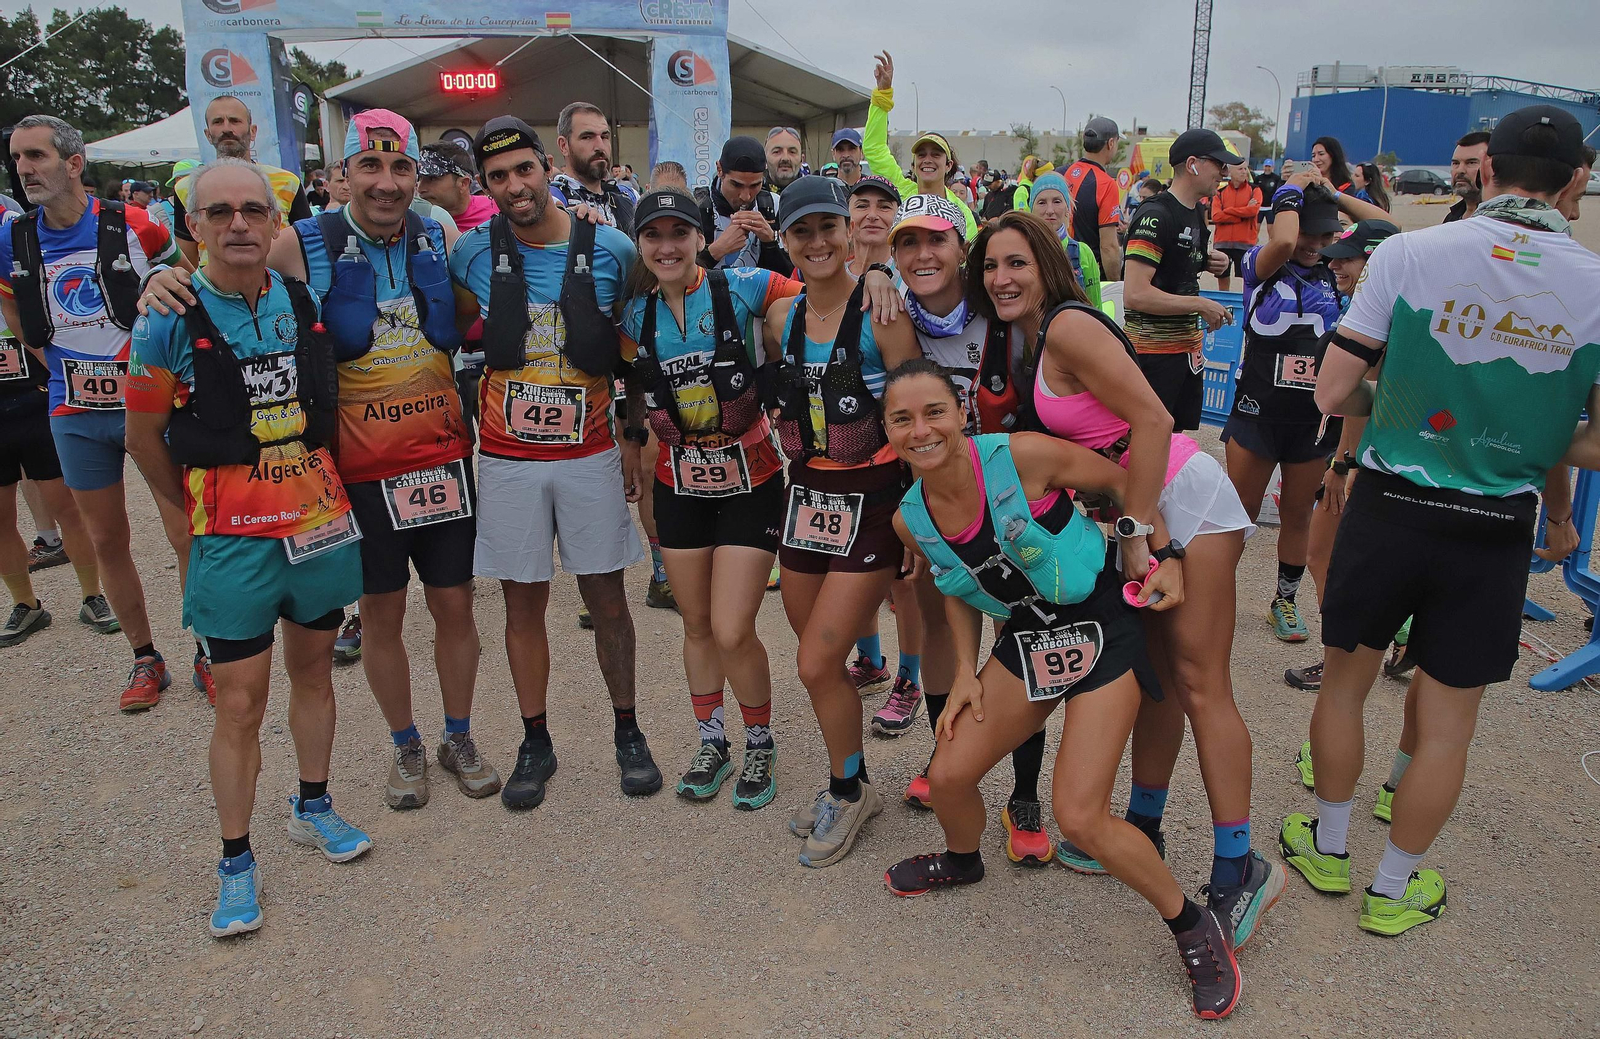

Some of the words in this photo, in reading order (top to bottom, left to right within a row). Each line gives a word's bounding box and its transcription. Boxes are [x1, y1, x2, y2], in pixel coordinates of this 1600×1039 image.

[394, 14, 412, 26] La
[450, 15, 463, 26] de
[465, 15, 476, 26] la
[479, 15, 539, 28] Concepción
[443, 73, 497, 89] 0:00:00
[691, 107, 711, 191] bonera
[1140, 216, 1159, 229] MC
[1434, 299, 1487, 340] 10
[413, 349, 420, 358] &
[1503, 334, 1548, 352] EURAFRICA
[1550, 344, 1572, 356] TRAIL
[73, 368, 125, 376] CARBNERA
[76, 361, 94, 370] XIII
[83, 378, 118, 395] 40
[522, 383, 541, 396] XIII
[516, 392, 572, 405] CARBONERA
[280, 407, 288, 419] &
[523, 404, 563, 426] 42
[247, 453, 323, 484] Algeciras
[421, 469, 446, 477] CRESTA
[690, 466, 727, 483] 29
[396, 473, 453, 487] CARBONERA
[409, 484, 447, 507] 46
[802, 498, 851, 512] CRBONERA
[1383, 491, 1515, 521] #UNCLUBQUESONRIE
[231, 516, 241, 526] El
[243, 513, 279, 525] Cerezo
[280, 509, 301, 522] Rojo
[809, 511, 842, 535] 48
[1030, 634, 1090, 652] CARBONERA
[1044, 648, 1084, 676] 92
